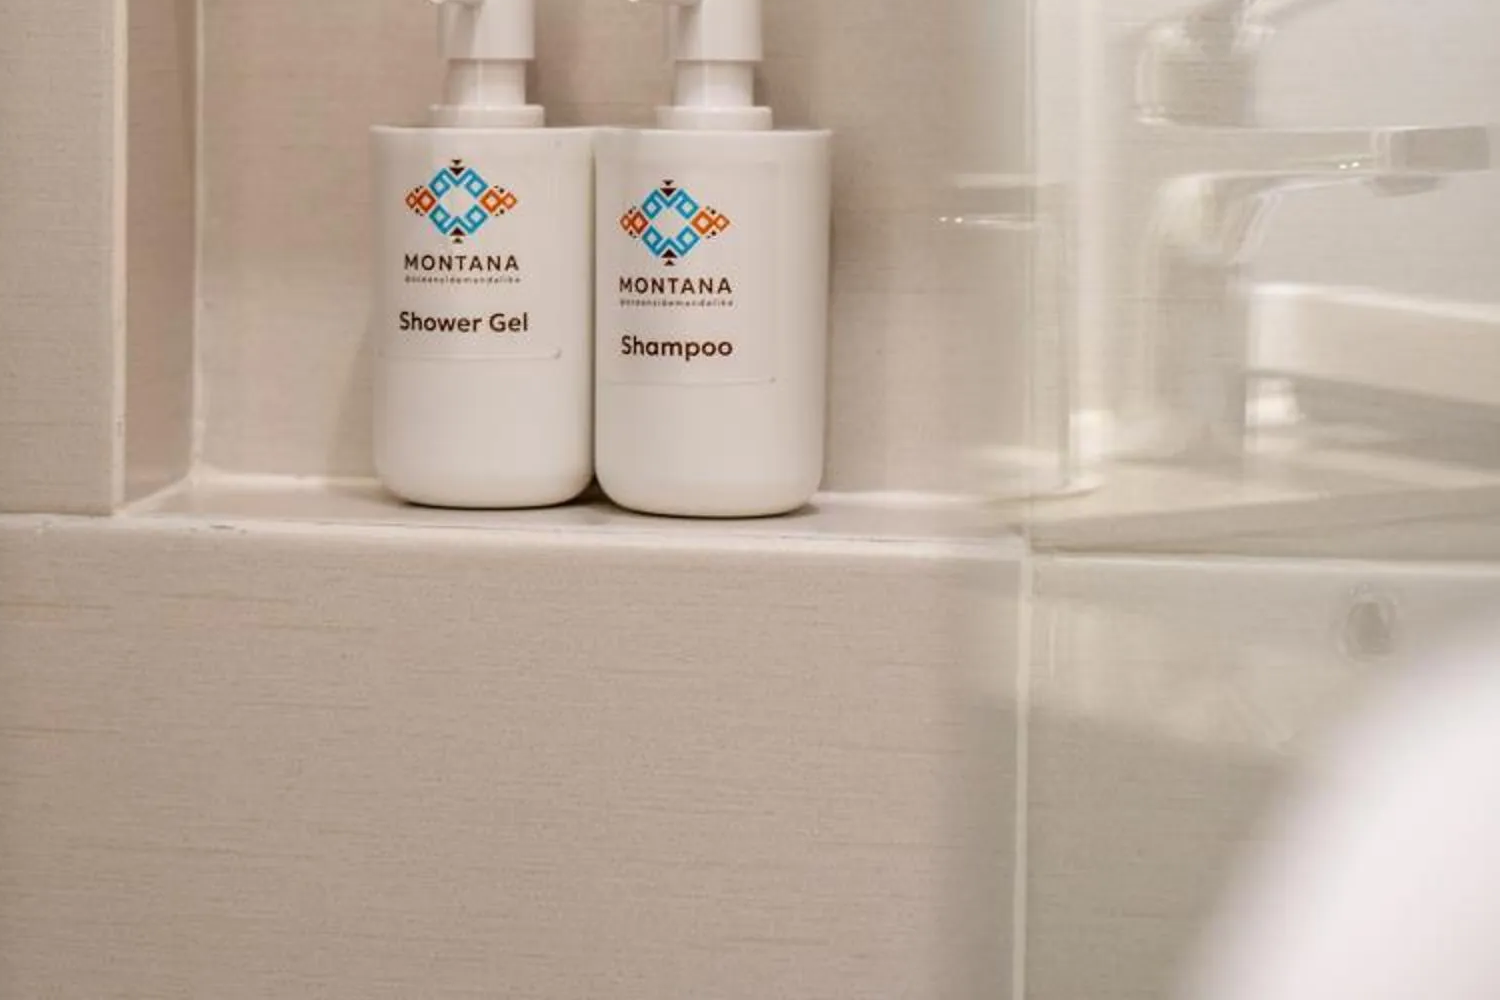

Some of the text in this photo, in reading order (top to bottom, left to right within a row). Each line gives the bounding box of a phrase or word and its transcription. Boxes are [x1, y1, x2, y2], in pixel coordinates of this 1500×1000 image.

[404, 253, 519, 271] MONTANA
[619, 276, 732, 294] MONTANA
[399, 311, 528, 332] Shower Gel
[621, 335, 733, 361] Shampoo
